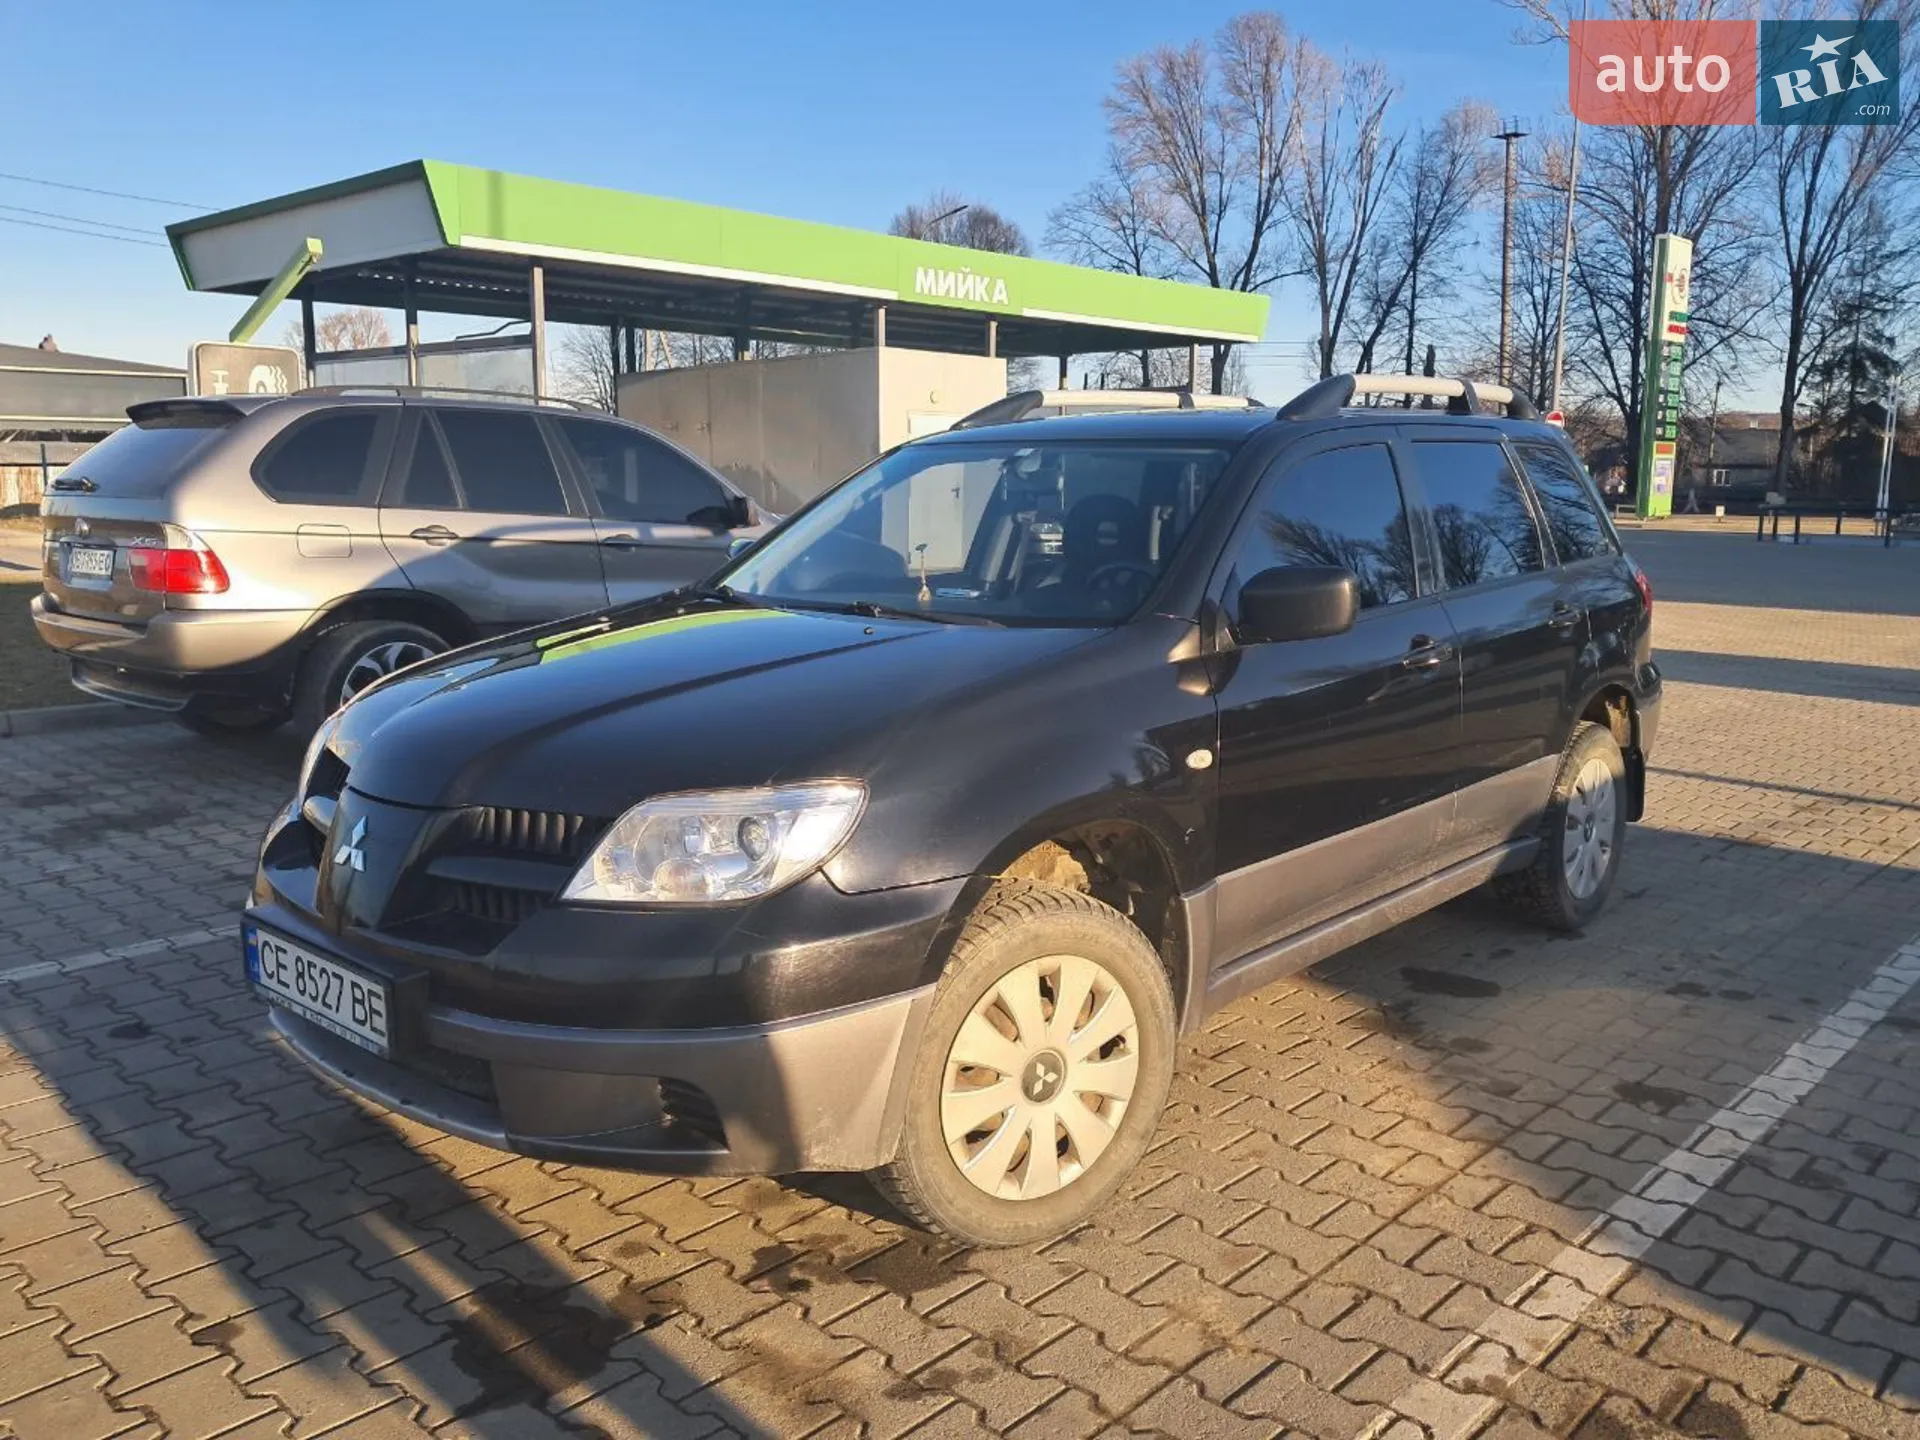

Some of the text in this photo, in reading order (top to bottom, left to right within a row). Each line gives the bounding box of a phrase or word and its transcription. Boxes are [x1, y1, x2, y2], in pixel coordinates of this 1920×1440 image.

[915, 266, 1009, 305] МИЙКА
[261, 940, 290, 990] CE
[295, 955, 344, 1014] 8527
[351, 981, 386, 1037] BE
